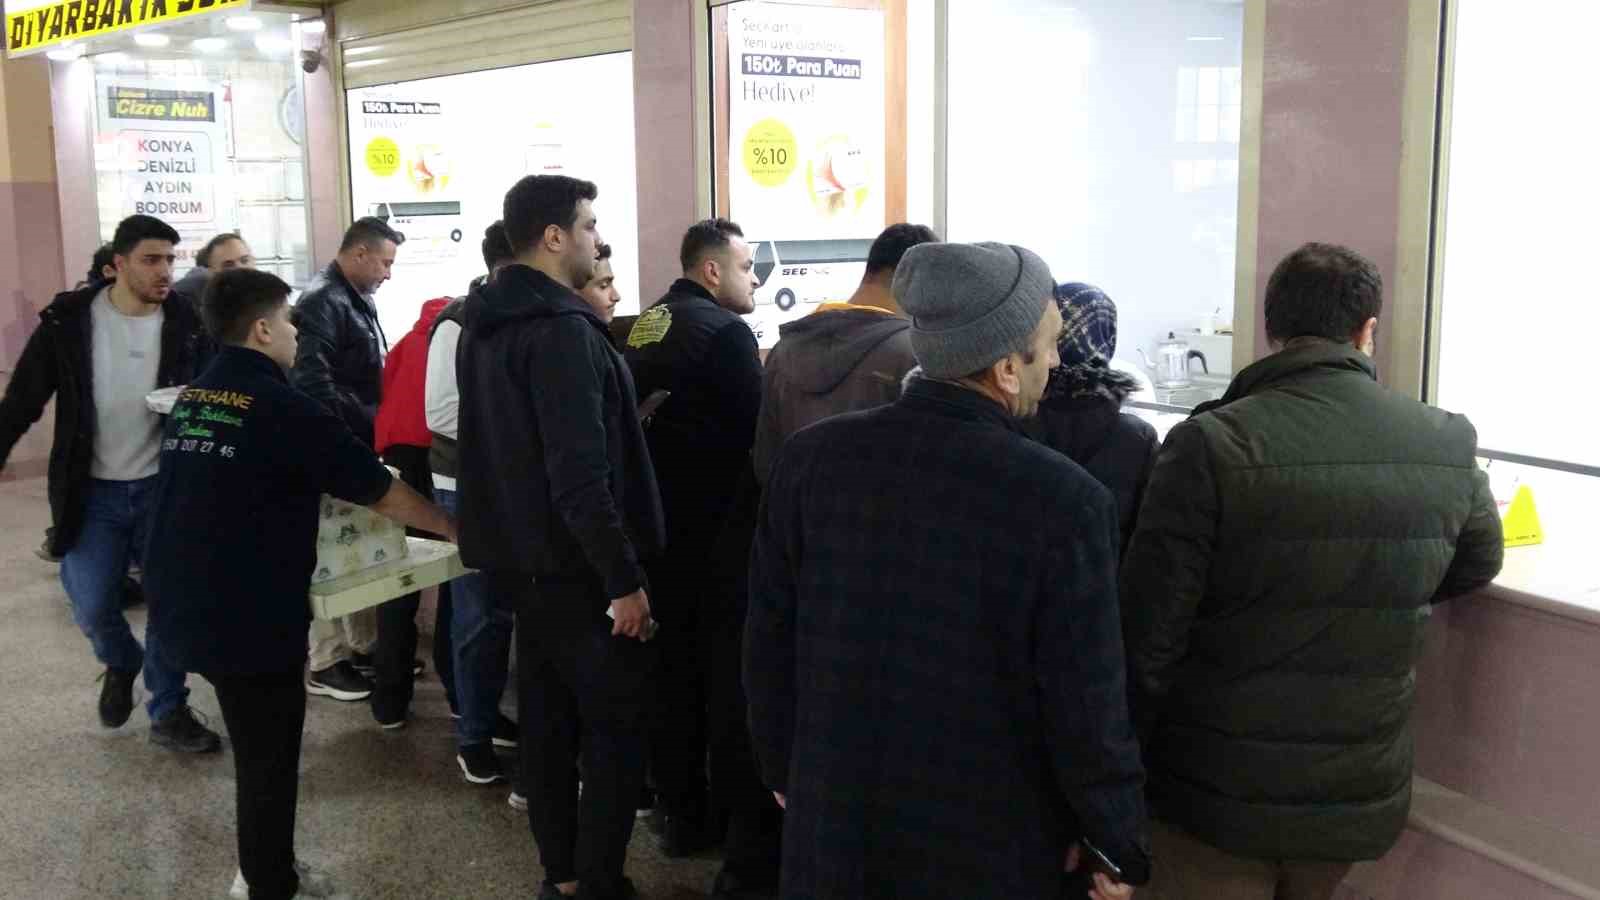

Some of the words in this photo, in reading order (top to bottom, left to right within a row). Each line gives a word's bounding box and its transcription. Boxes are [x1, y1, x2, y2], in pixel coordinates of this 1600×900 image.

[786, 57, 822, 75] Para
[824, 58, 860, 77] Puan
[743, 79, 816, 105] Hediye!
[117, 99, 166, 116] Cizre
[171, 101, 209, 118] Nuh
[137, 139, 194, 153] KONYA
[371, 153, 395, 165] %10
[752, 147, 788, 165] %10
[137, 158, 197, 173] DENİZLİ
[135, 201, 203, 215] BODRUM
[219, 444, 236, 458] 45
